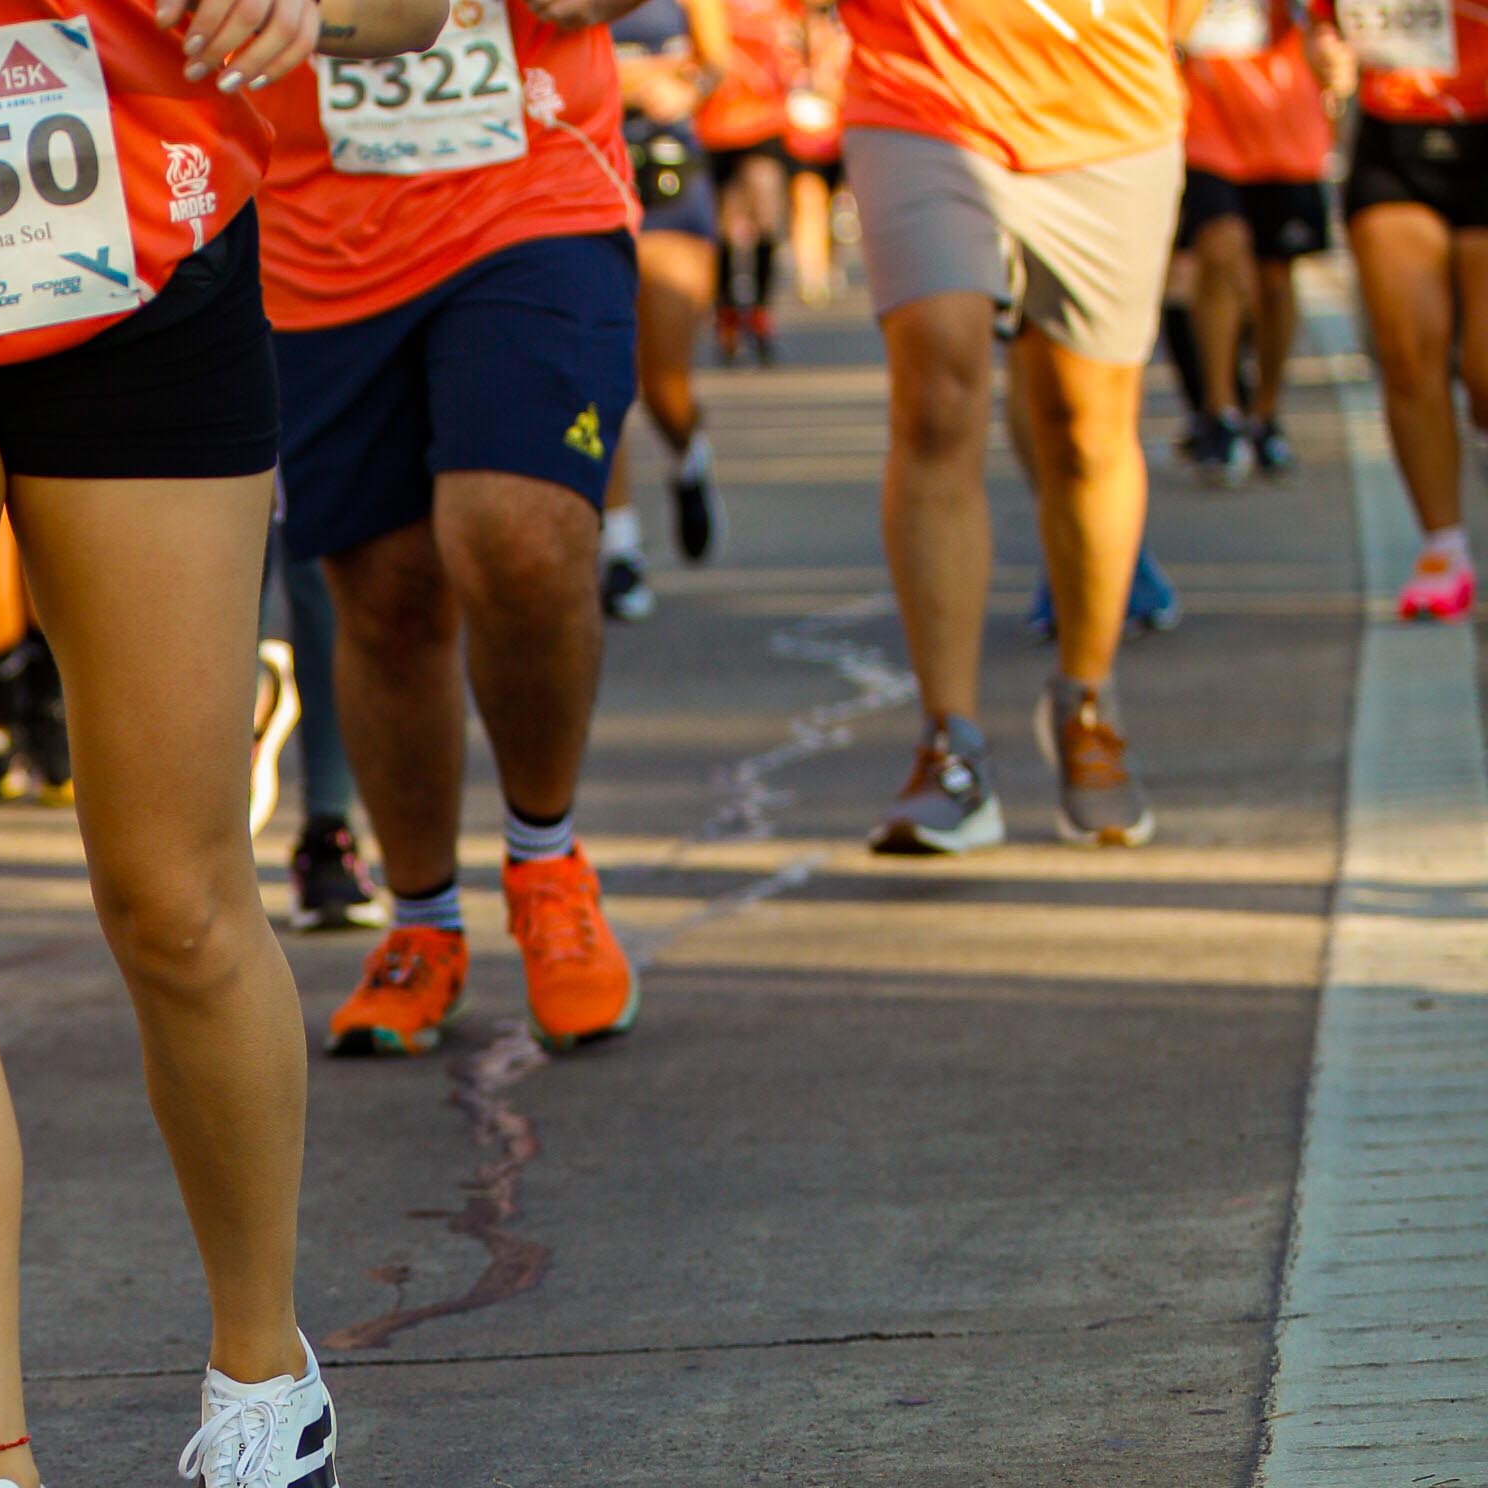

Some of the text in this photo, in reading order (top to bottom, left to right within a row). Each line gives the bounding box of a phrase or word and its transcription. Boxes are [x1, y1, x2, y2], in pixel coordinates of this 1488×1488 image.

[1, 64, 46, 90] 15K
[329, 40, 510, 110] 5322
[169, 192, 216, 223] ARDEC
[20, 221, 53, 248] Sol
